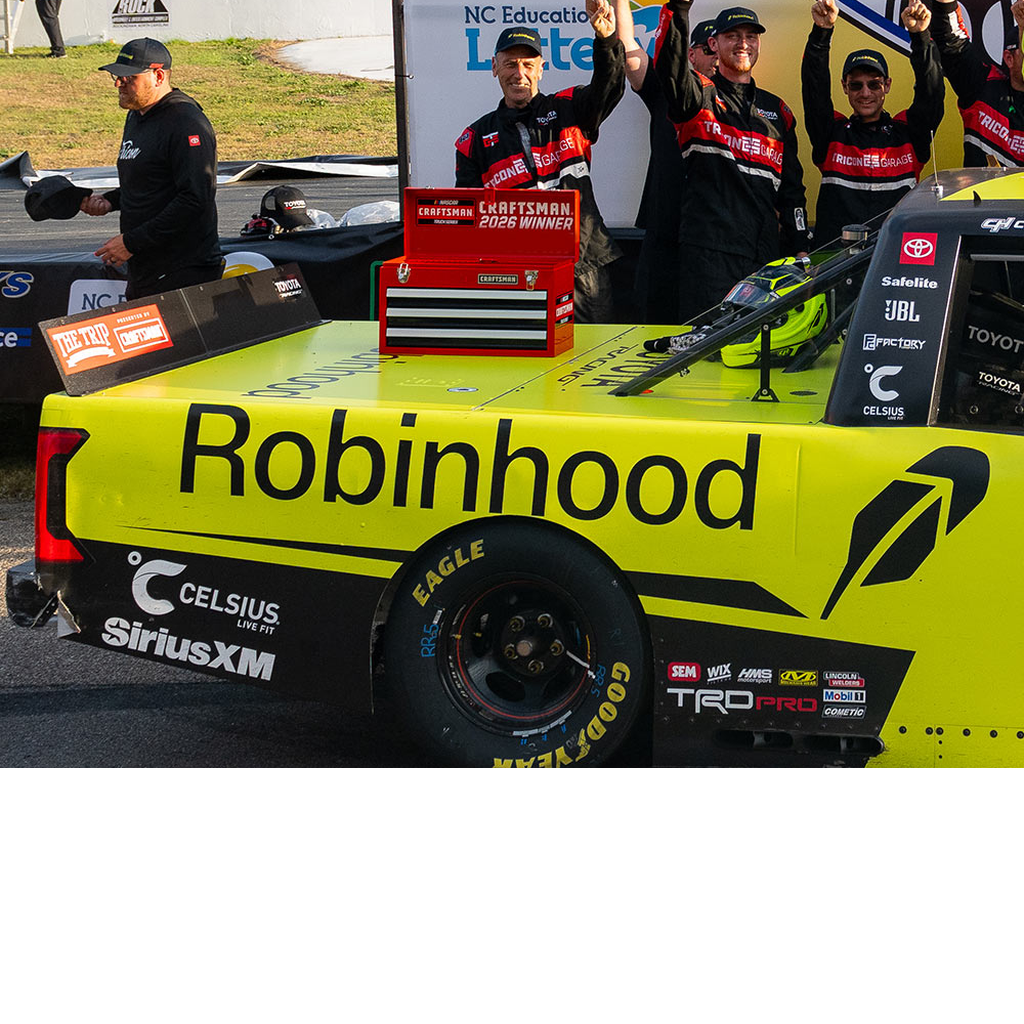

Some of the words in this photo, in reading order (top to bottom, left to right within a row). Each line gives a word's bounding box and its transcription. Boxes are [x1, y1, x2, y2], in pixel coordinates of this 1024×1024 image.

[465, 6, 496, 23] NC
[502, 6, 589, 23] Educatio
[881, 153, 913, 168] GARAGE
[418, 207, 473, 216] CRAFTSMAN
[479, 201, 570, 216] CRAFTSMAN
[479, 215, 517, 229] 2026
[519, 215, 574, 230] WINNER
[274, 278, 302, 291] TOYOTA
[881, 276, 938, 289] Safelite
[82, 294, 112, 310] NC
[885, 300, 920, 322] JBL
[52, 330, 82, 357] THE
[78, 323, 111, 347] TRIP
[978, 371, 1021, 392] TOYOTA
[863, 406, 904, 416] CELSIUS
[179, 403, 762, 531] Robinhood
[412, 539, 485, 607] EAGLE
[179, 582, 279, 625] CELSIUS
[237, 619, 257, 633] LIVE
[259, 625, 275, 635] FIT
[102, 617, 276, 681] SiriusXM
[672, 665, 697, 678] SEM
[707, 663, 731, 678] WIX
[738, 668, 772, 678] HMS
[667, 688, 753, 714] TRD
[756, 696, 818, 712] PRO
[825, 691, 852, 700] Mobil
[824, 708, 864, 718] COMETIC
